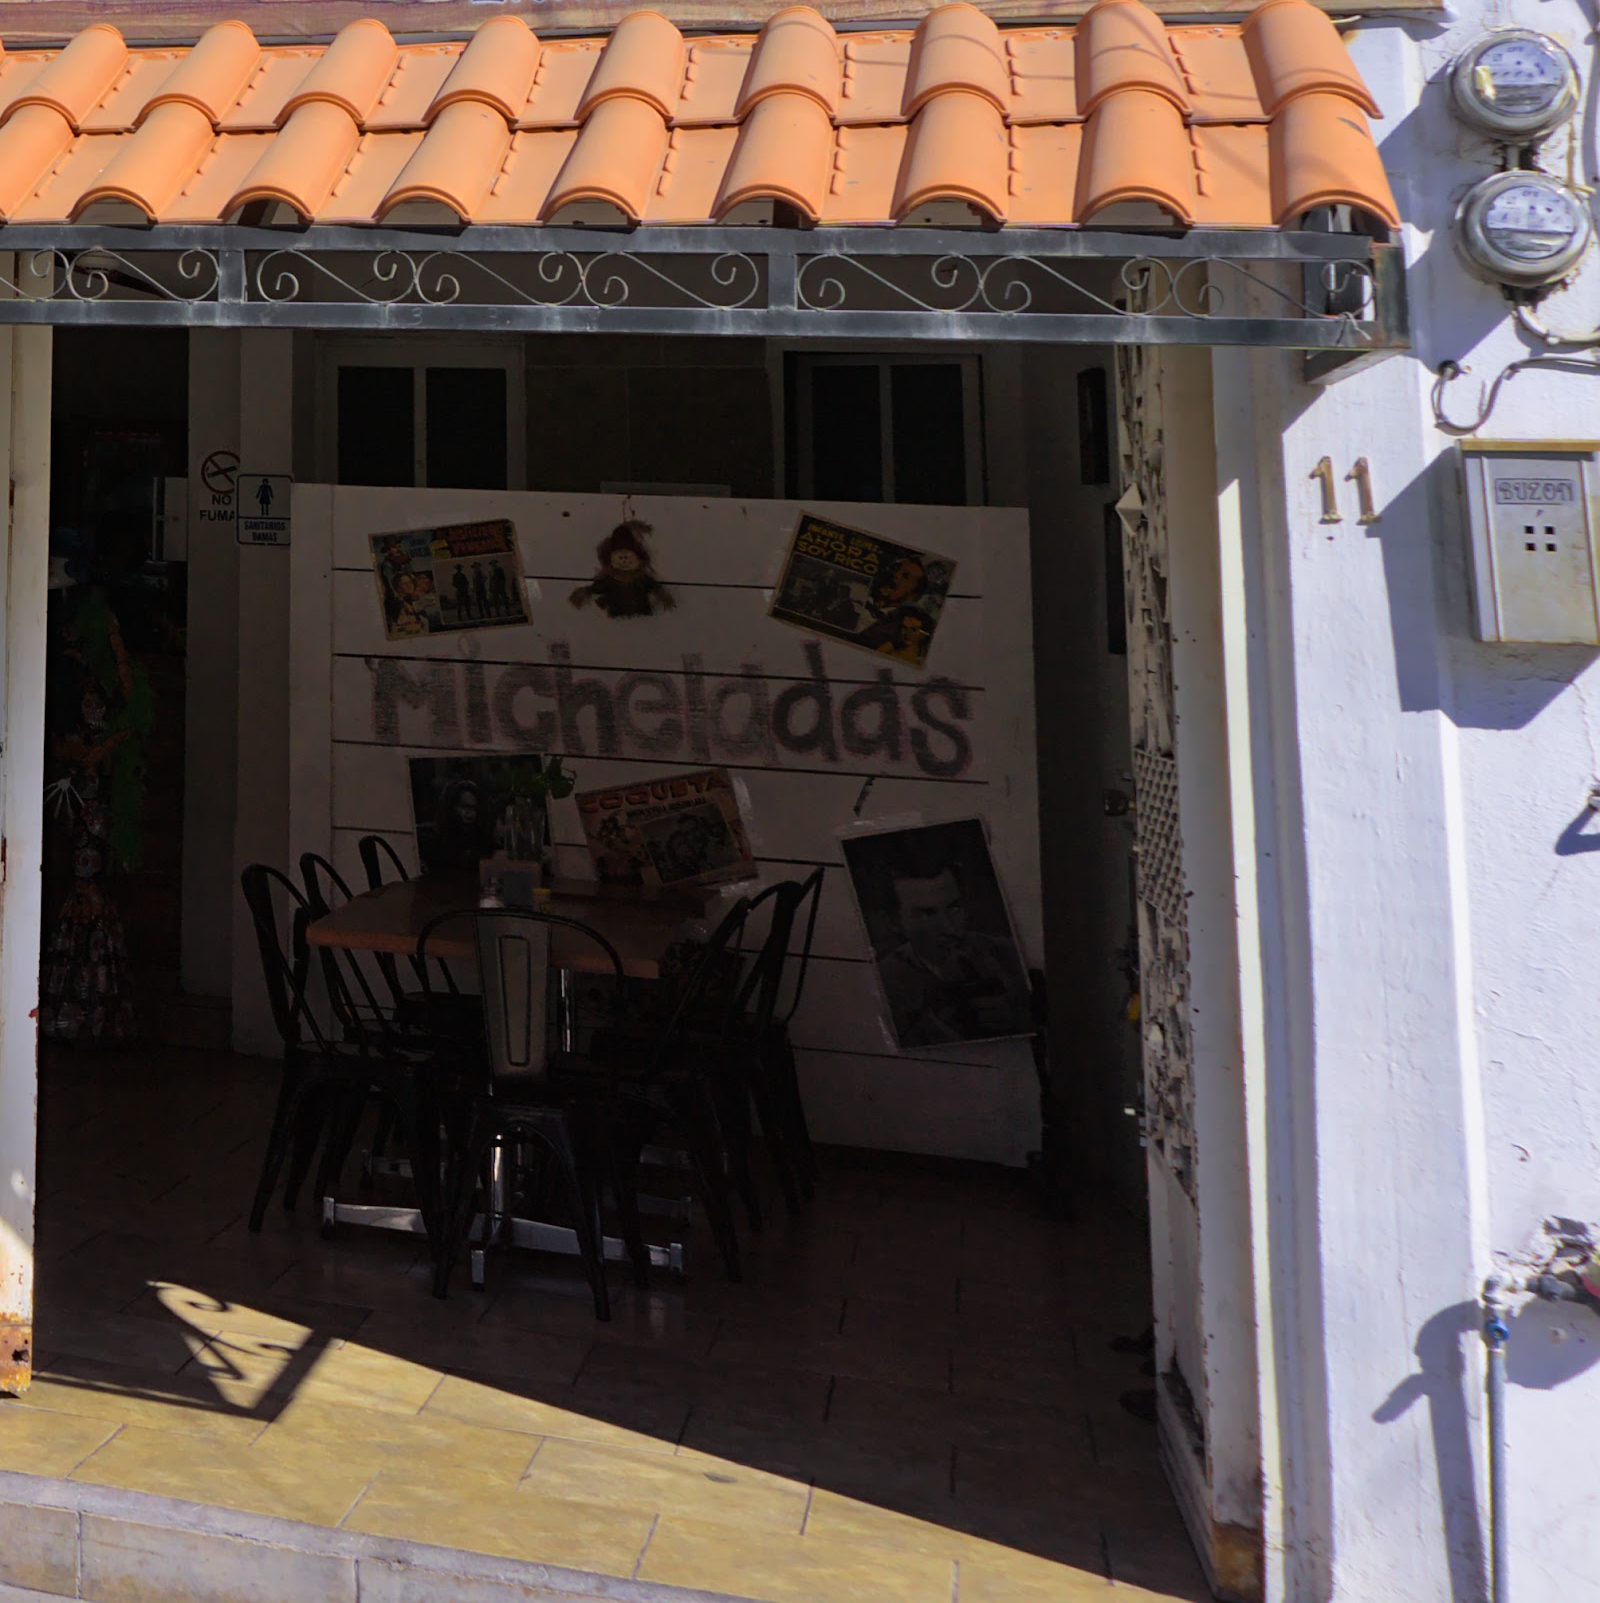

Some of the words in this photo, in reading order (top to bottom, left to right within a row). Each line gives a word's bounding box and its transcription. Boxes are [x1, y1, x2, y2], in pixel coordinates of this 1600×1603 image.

[211, 494, 232, 506] NO
[1309, 455, 1381, 524] 11
[1498, 481, 1574, 502] BUZON
[199, 509, 235, 522] FUMA
[251, 531, 278, 542] DAMAS
[800, 531, 880, 566] AHORA
[797, 540, 832, 558] SOY
[834, 552, 880, 575] RICO
[366, 636, 973, 778] Micheladas
